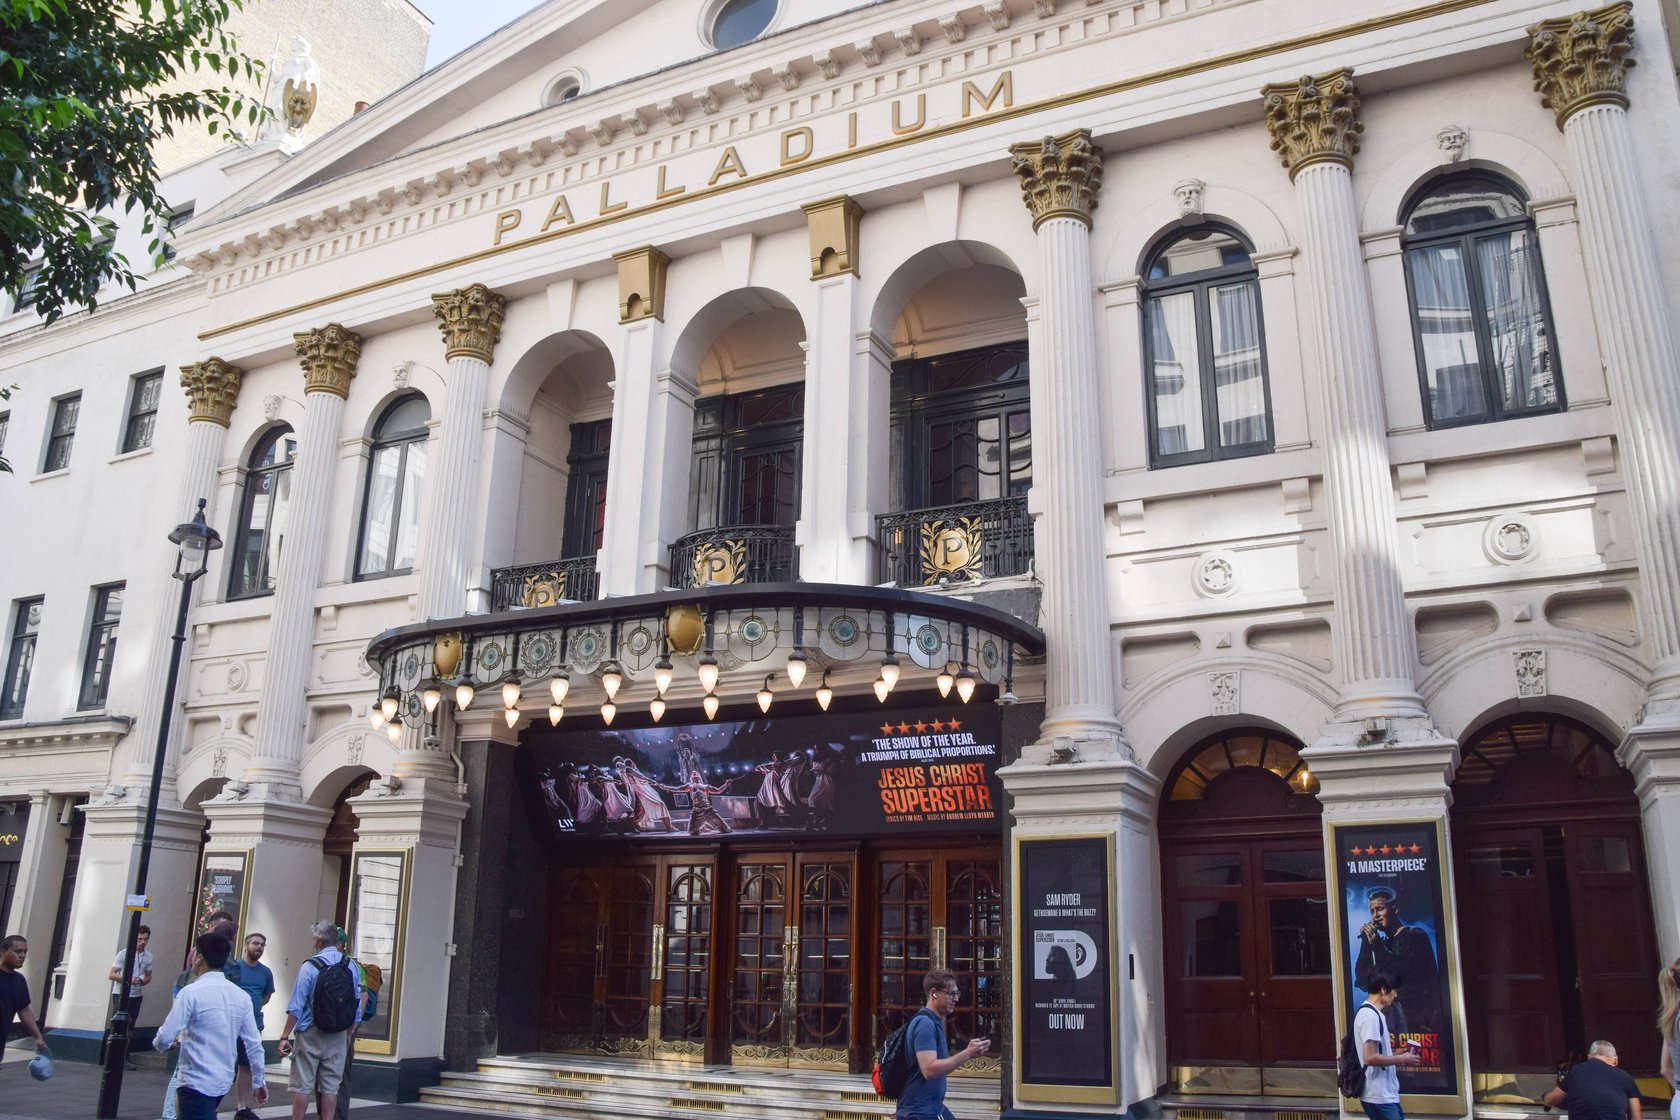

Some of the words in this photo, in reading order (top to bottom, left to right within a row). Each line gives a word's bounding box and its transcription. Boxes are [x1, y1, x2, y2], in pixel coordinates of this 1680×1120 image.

[494, 70, 1013, 245] PALLADIUM
[892, 736, 920, 750] SHOW
[921, 735, 931, 748] OF
[932, 734, 950, 747] THE
[950, 733, 976, 746] YEAR.
[861, 752, 867, 762] A
[867, 751, 900, 762] TRIUMPH
[900, 750, 909, 760] OF
[910, 748, 942, 760] BIBLICAL
[878, 766, 926, 789] JESUS
[930, 763, 986, 786] CHRIST
[881, 785, 993, 814] SUPERSTAR
[1358, 858, 1427, 873] MASTERPIECE'
[1046, 893, 1060, 906] SAM
[1061, 893, 1081, 906] RYDER
[1049, 1013, 1063, 1029] OUT
[1065, 1014, 1084, 1030] NOW
